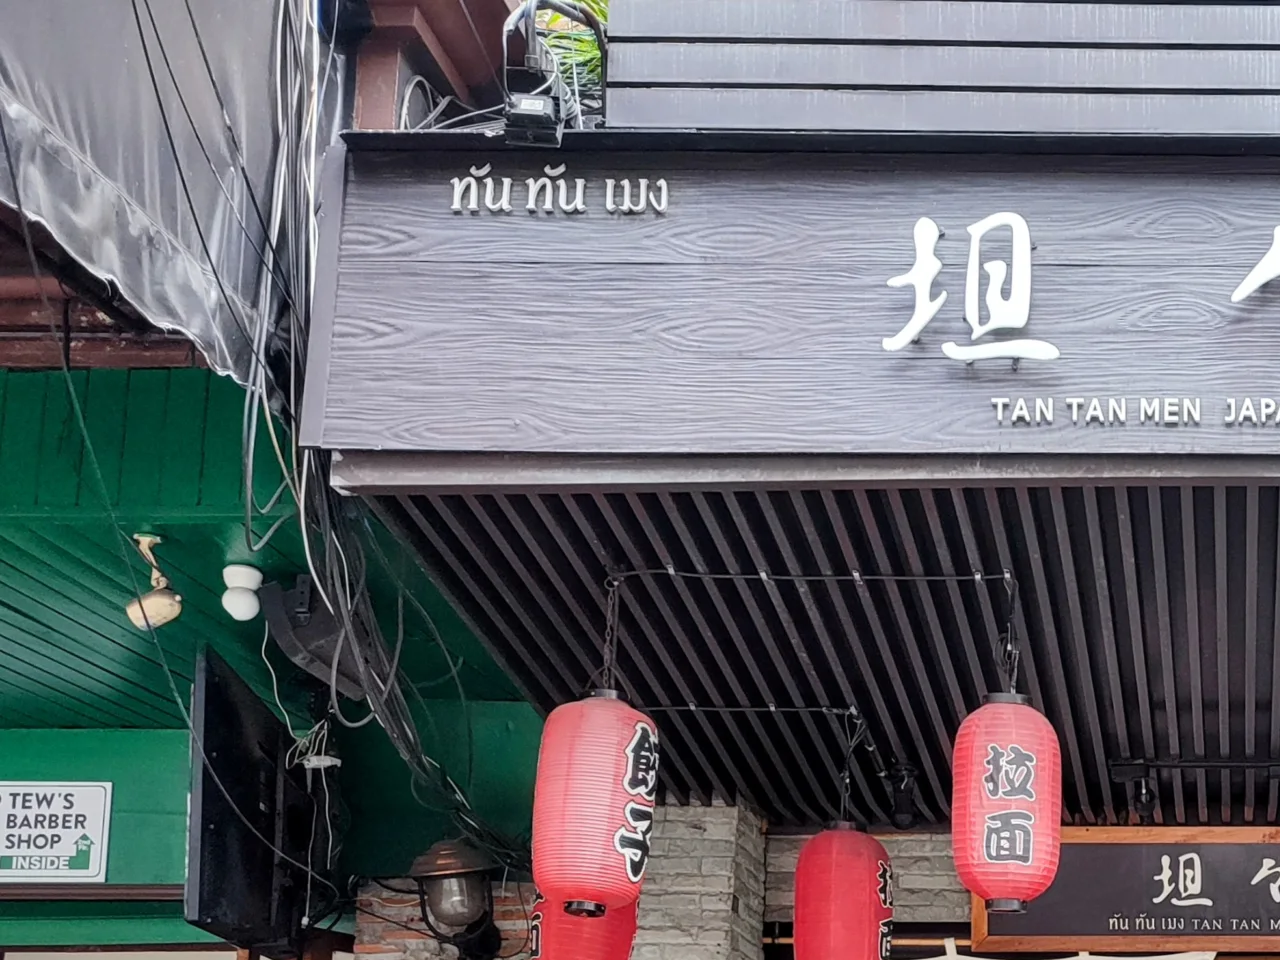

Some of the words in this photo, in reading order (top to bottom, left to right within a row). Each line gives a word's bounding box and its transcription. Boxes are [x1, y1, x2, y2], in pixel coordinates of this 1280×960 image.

[450, 162, 514, 212] ทัน
[525, 162, 587, 213] ทัน
[604, 177, 669, 213] เมง
[991, 398, 1054, 425] TAN
[1066, 398, 1128, 425] TAN
[1139, 398, 1202, 425] MEN
[9, 792, 75, 810] TEW'S
[984, 743, 1037, 866] 拉面
[6, 813, 87, 830] BARBER
[5, 833, 62, 850] SHOP
[12, 855, 70, 870] INSIDE
[1108, 912, 1130, 931] ทัน
[1135, 912, 1156, 931] ทัน
[1161, 916, 1185, 931] เมง
[1192, 918, 1223, 930] TAN
[1230, 918, 1261, 930] TAN
